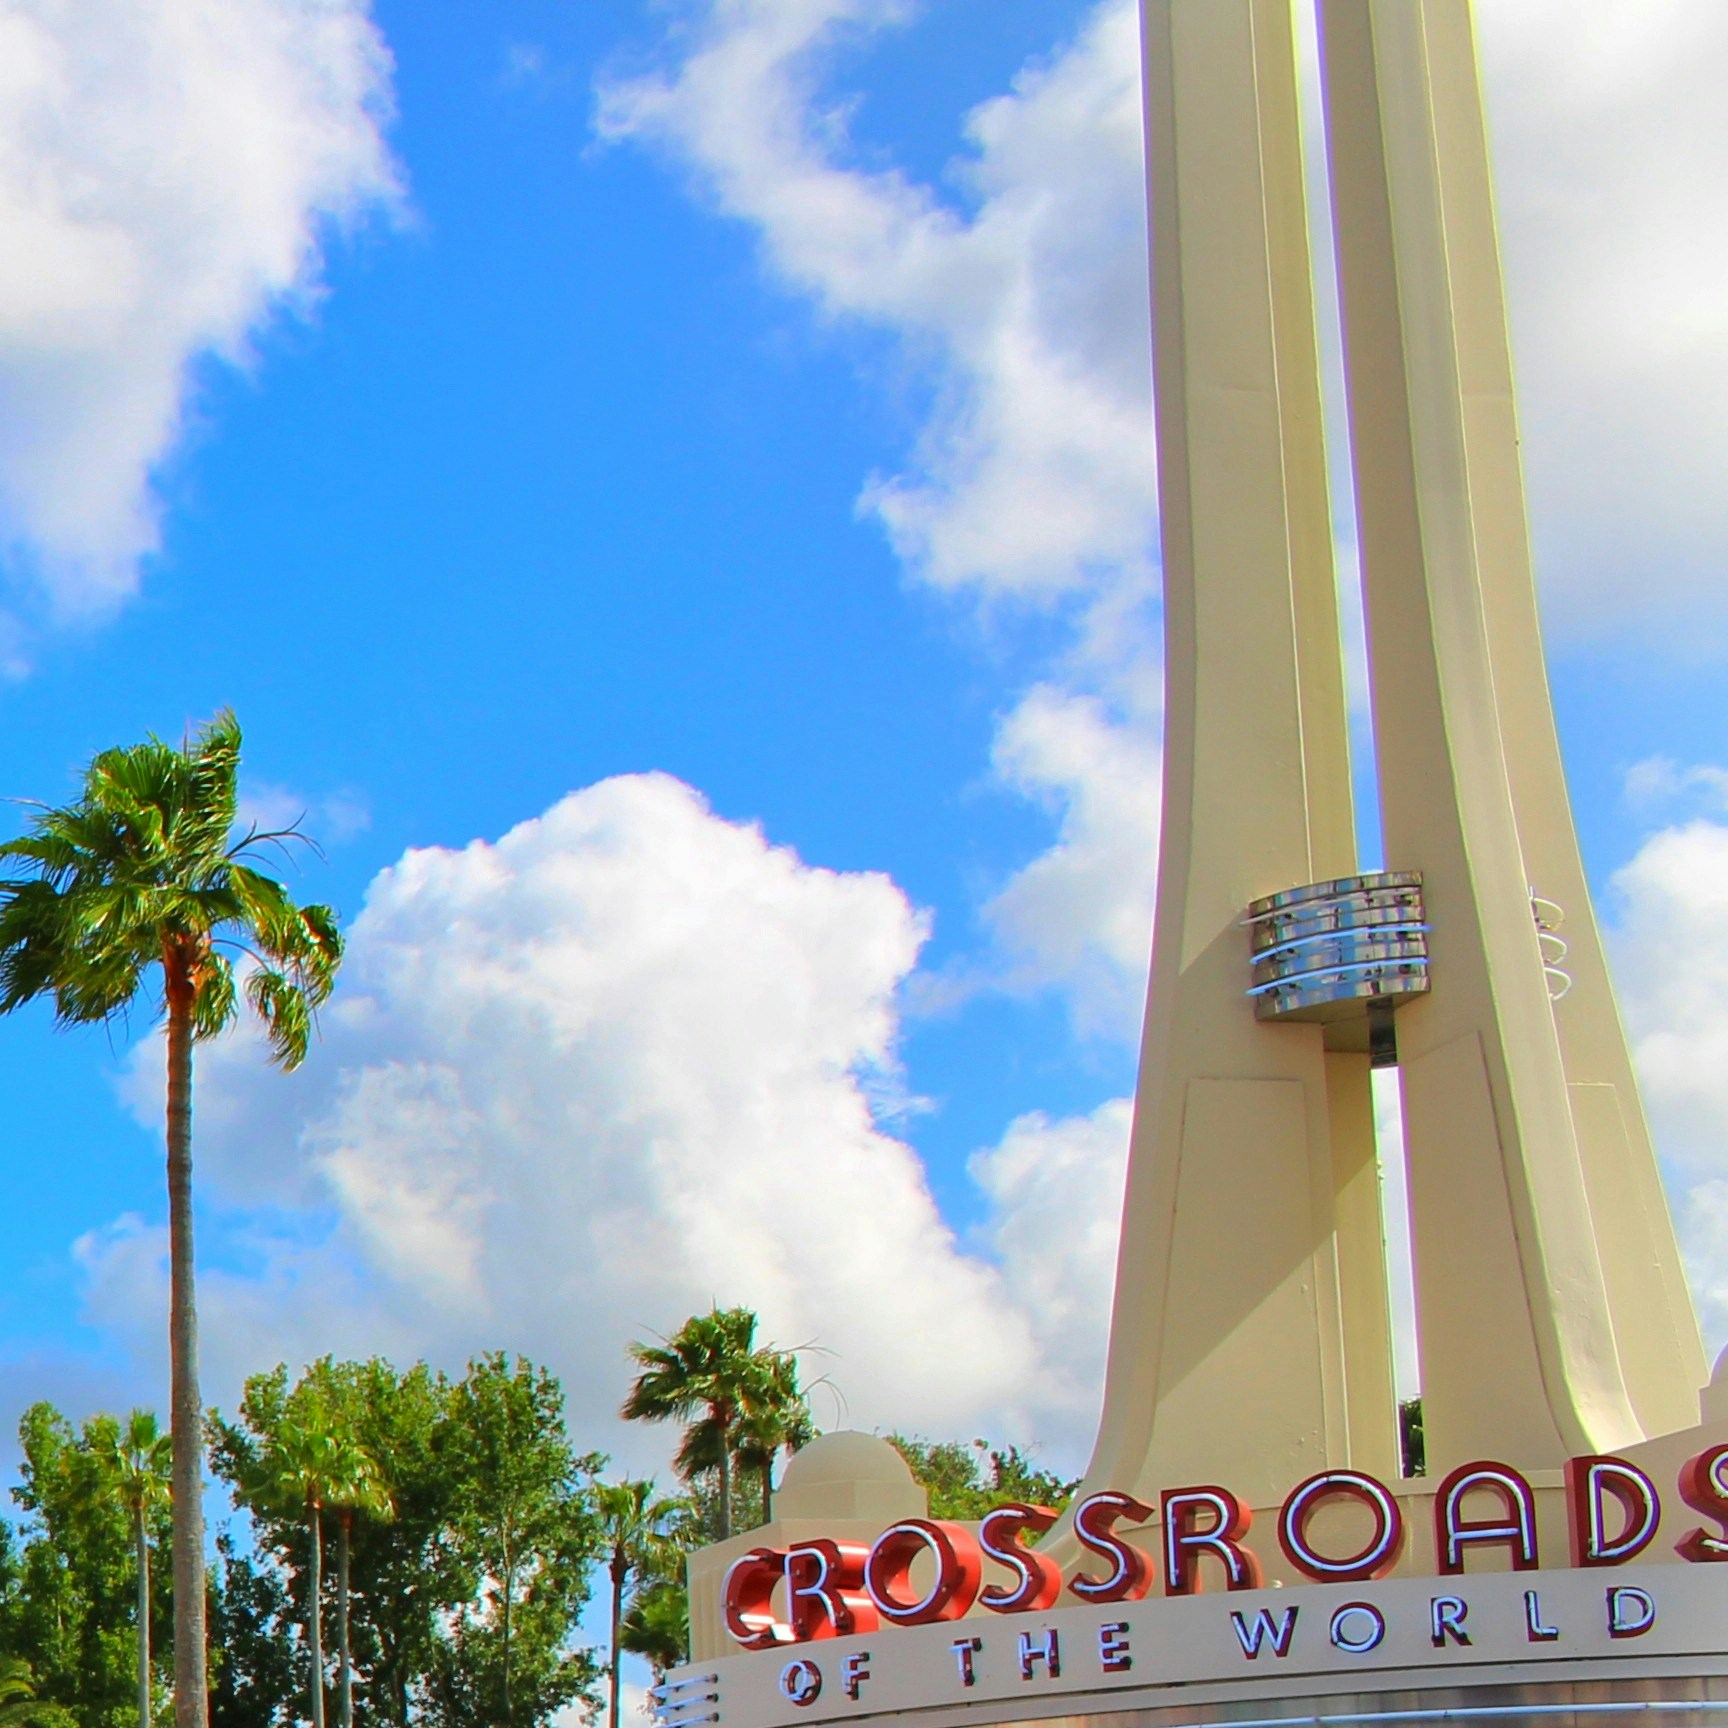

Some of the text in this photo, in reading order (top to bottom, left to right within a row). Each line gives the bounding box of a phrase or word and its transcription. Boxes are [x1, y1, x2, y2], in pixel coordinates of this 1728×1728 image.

[779, 1586, 1656, 1706] OF THE WORLD
